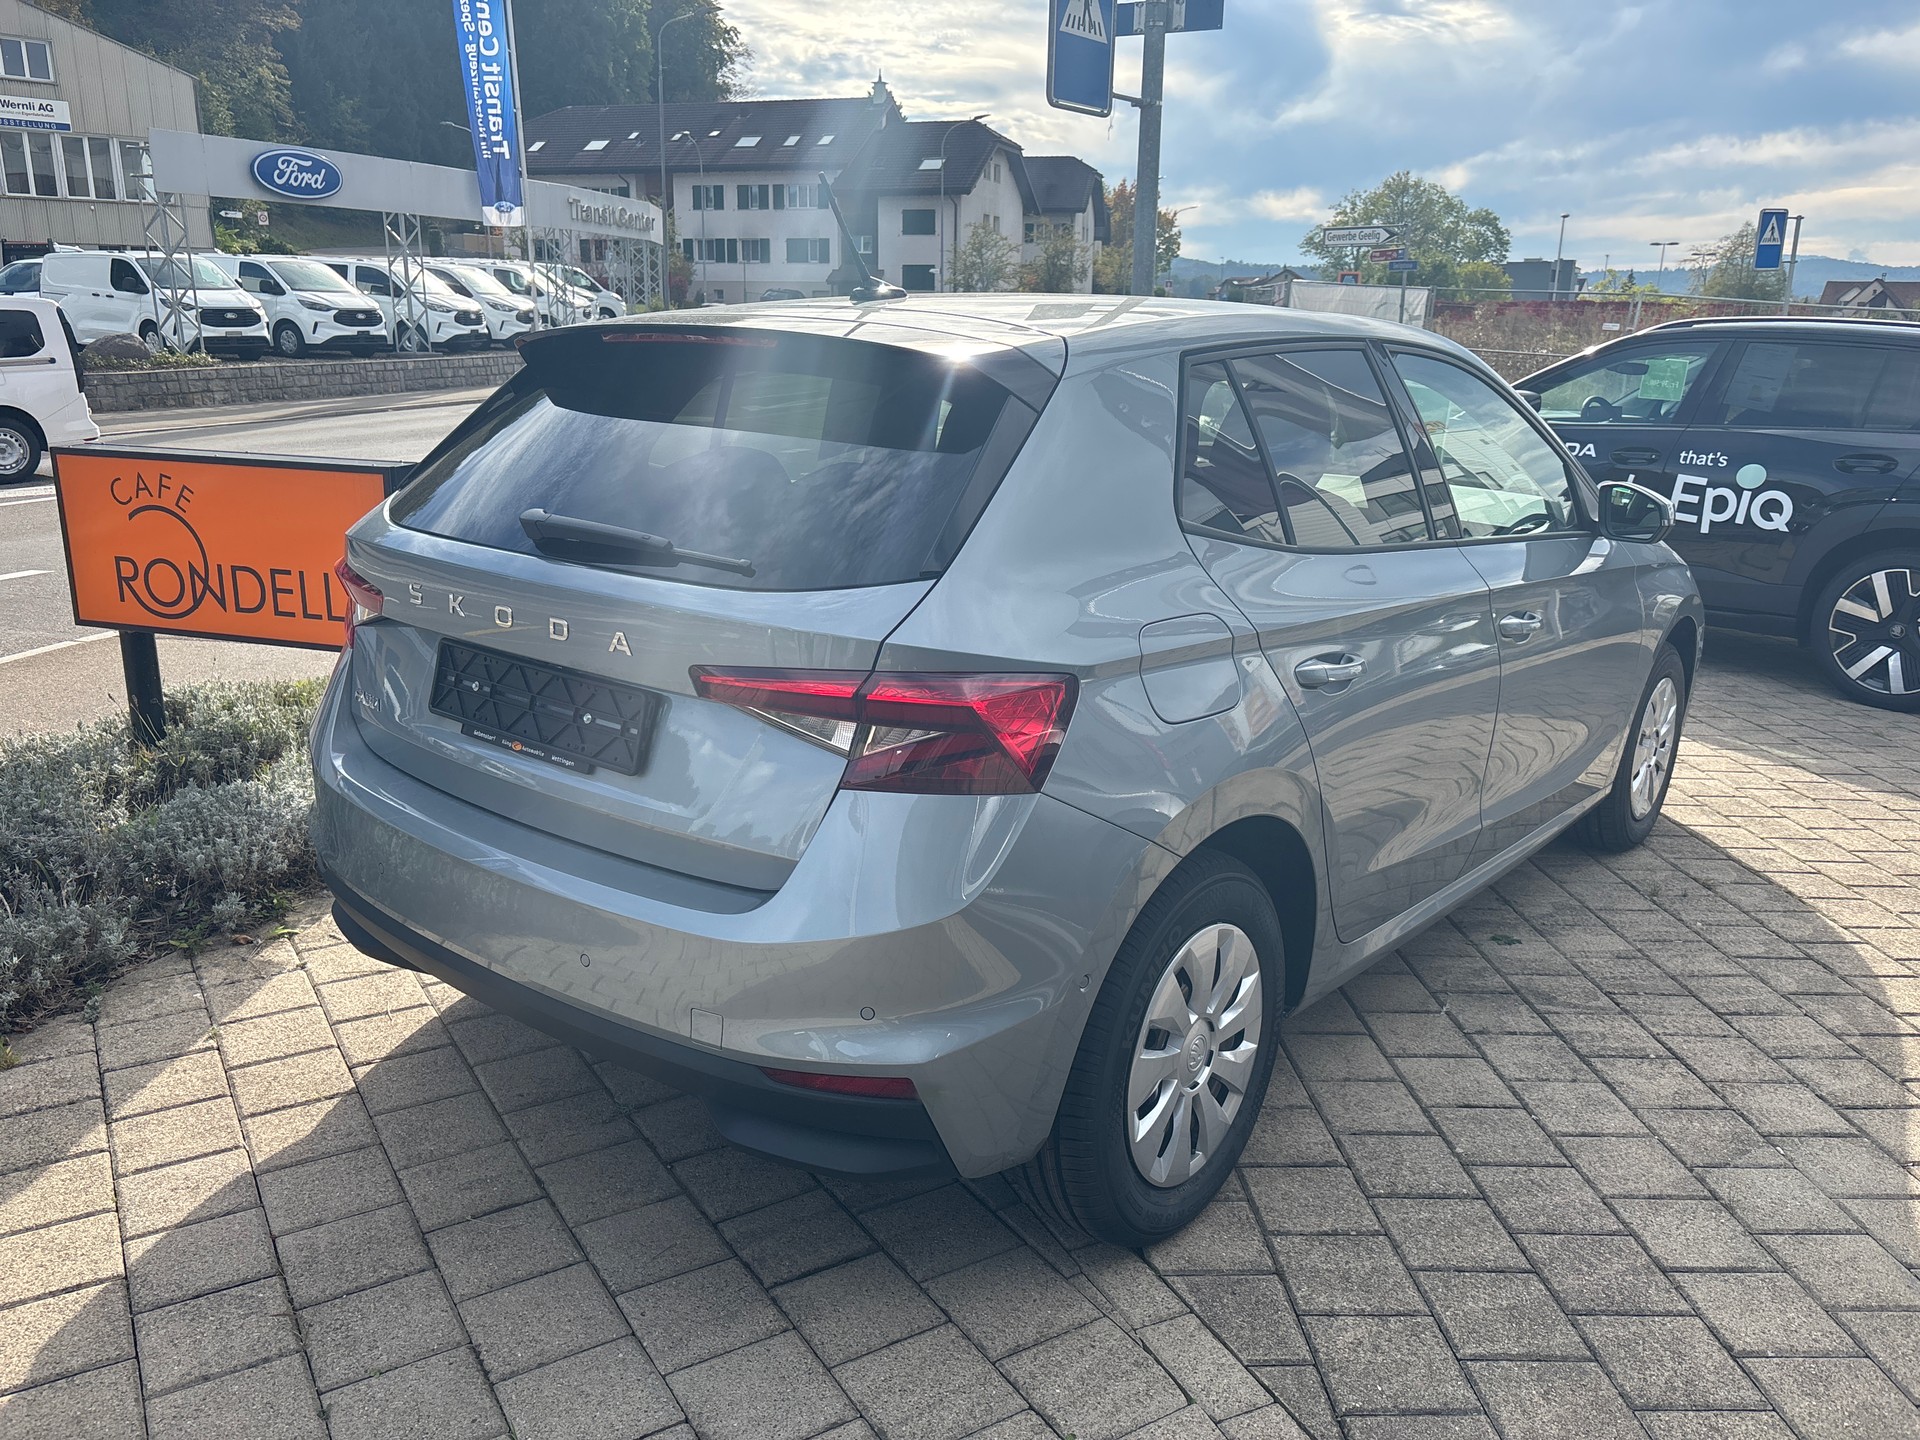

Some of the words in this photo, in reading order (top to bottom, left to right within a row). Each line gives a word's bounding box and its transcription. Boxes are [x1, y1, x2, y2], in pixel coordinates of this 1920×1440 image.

[0, 99, 35, 111] Wernli
[38, 102, 54, 113] AG
[273, 156, 326, 189] Ford
[567, 197, 616, 227] Transit
[616, 206, 656, 231] Center
[1326, 231, 1357, 242] Gewerbe
[1358, 230, 1381, 243] Geelig
[1679, 449, 1729, 467] that's
[110, 471, 194, 514] CAFE
[1670, 463, 1793, 534] EpiQ
[521, 745, 545, 757] Automobile
[551, 754, 575, 766] Wettingen
